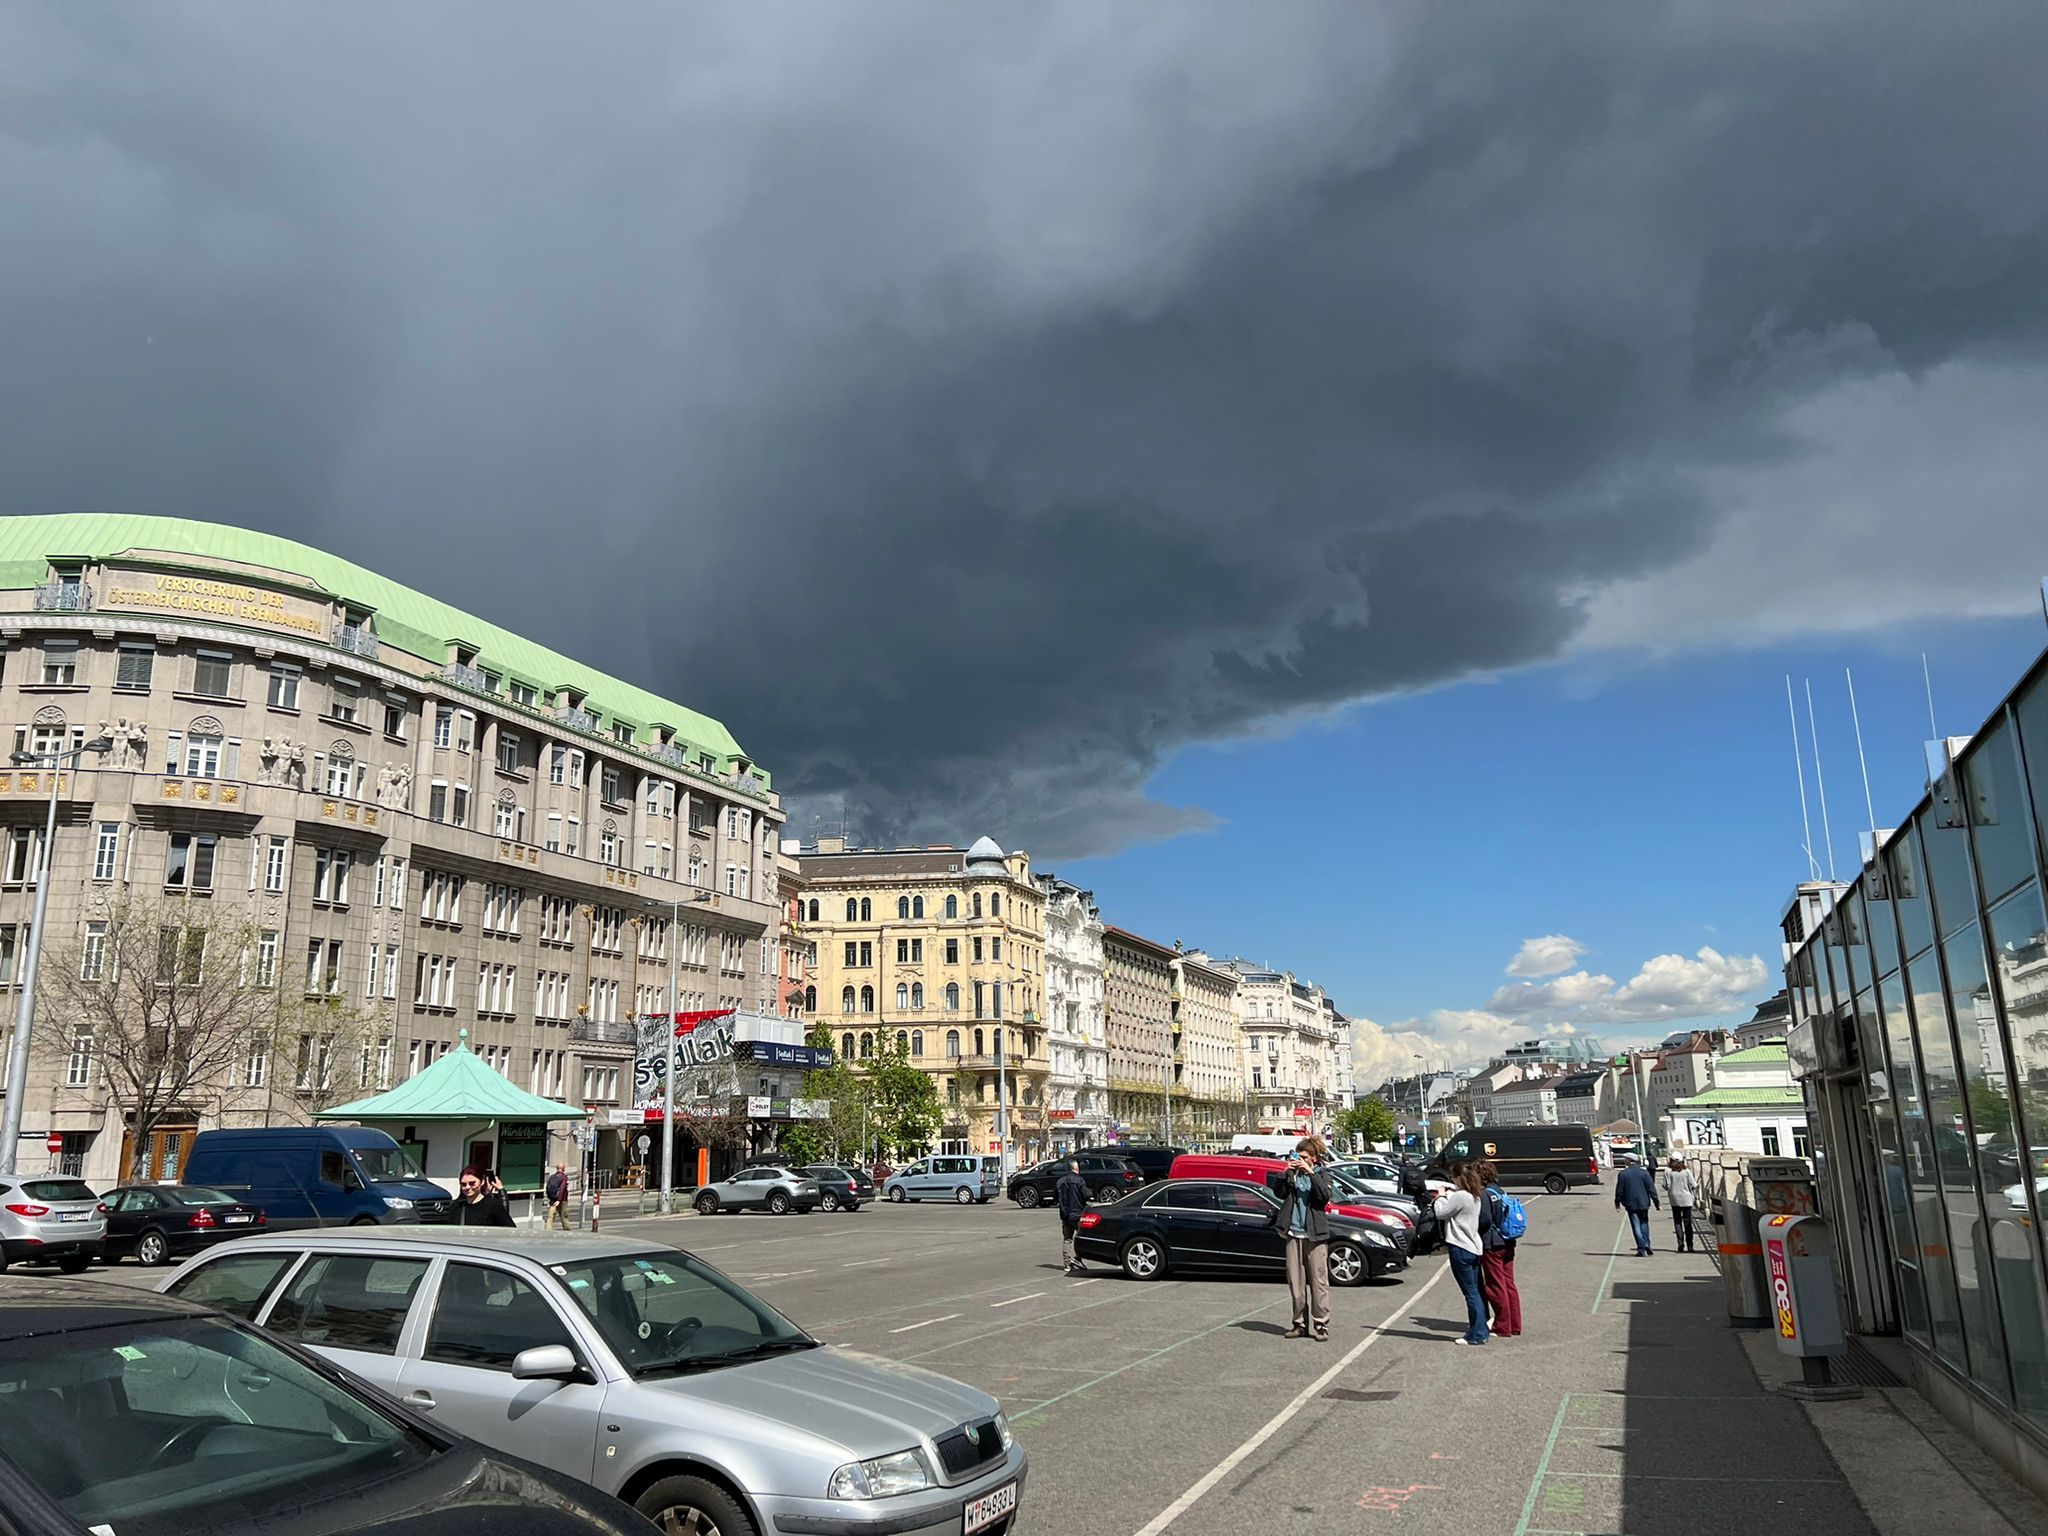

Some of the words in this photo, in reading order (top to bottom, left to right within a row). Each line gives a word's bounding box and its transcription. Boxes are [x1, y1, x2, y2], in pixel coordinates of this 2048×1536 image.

[108, 588, 234, 616] ÖSTERREICHISCHEN
[240, 605, 321, 634] EISENBAHNEN
[156, 576, 255, 602] VERSICHERUNG
[260, 591, 284, 609] DER
[967, 1506, 975, 1528] W
[981, 1490, 1008, 1521] 64933
